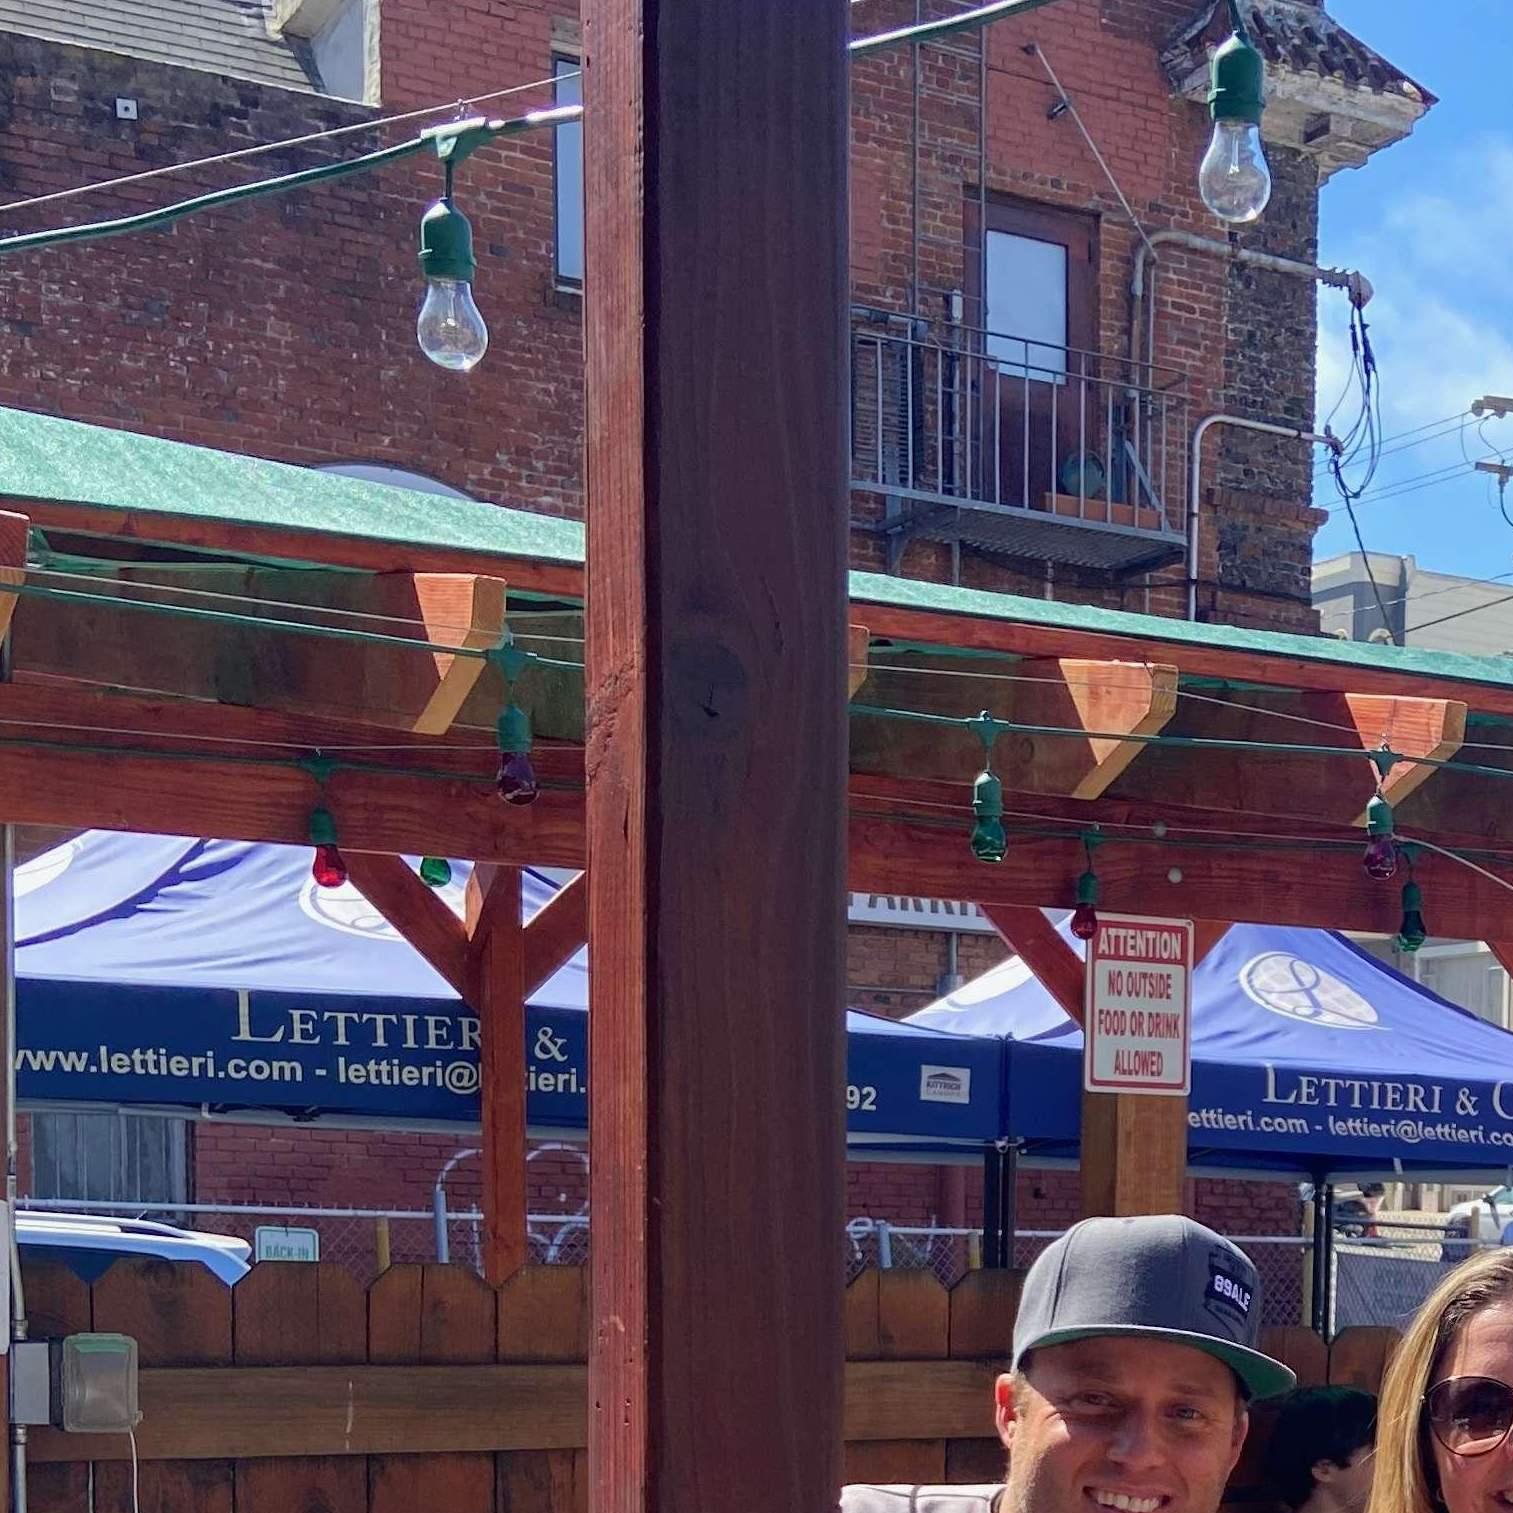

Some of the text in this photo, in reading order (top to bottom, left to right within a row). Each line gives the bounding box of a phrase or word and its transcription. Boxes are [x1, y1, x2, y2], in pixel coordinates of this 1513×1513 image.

[1098, 927, 1182, 960] ATTENTION
[1107, 970, 1172, 1000] NO OUTSIDE
[231, 988, 568, 1062] LETTIER &
[1098, 1008, 1180, 1039] FOOD OR DRINK
[1113, 1050, 1163, 1077] ALLOWED
[1262, 1064, 1443, 1114] LETTIERI
[1455, 1087, 1479, 1117] &
